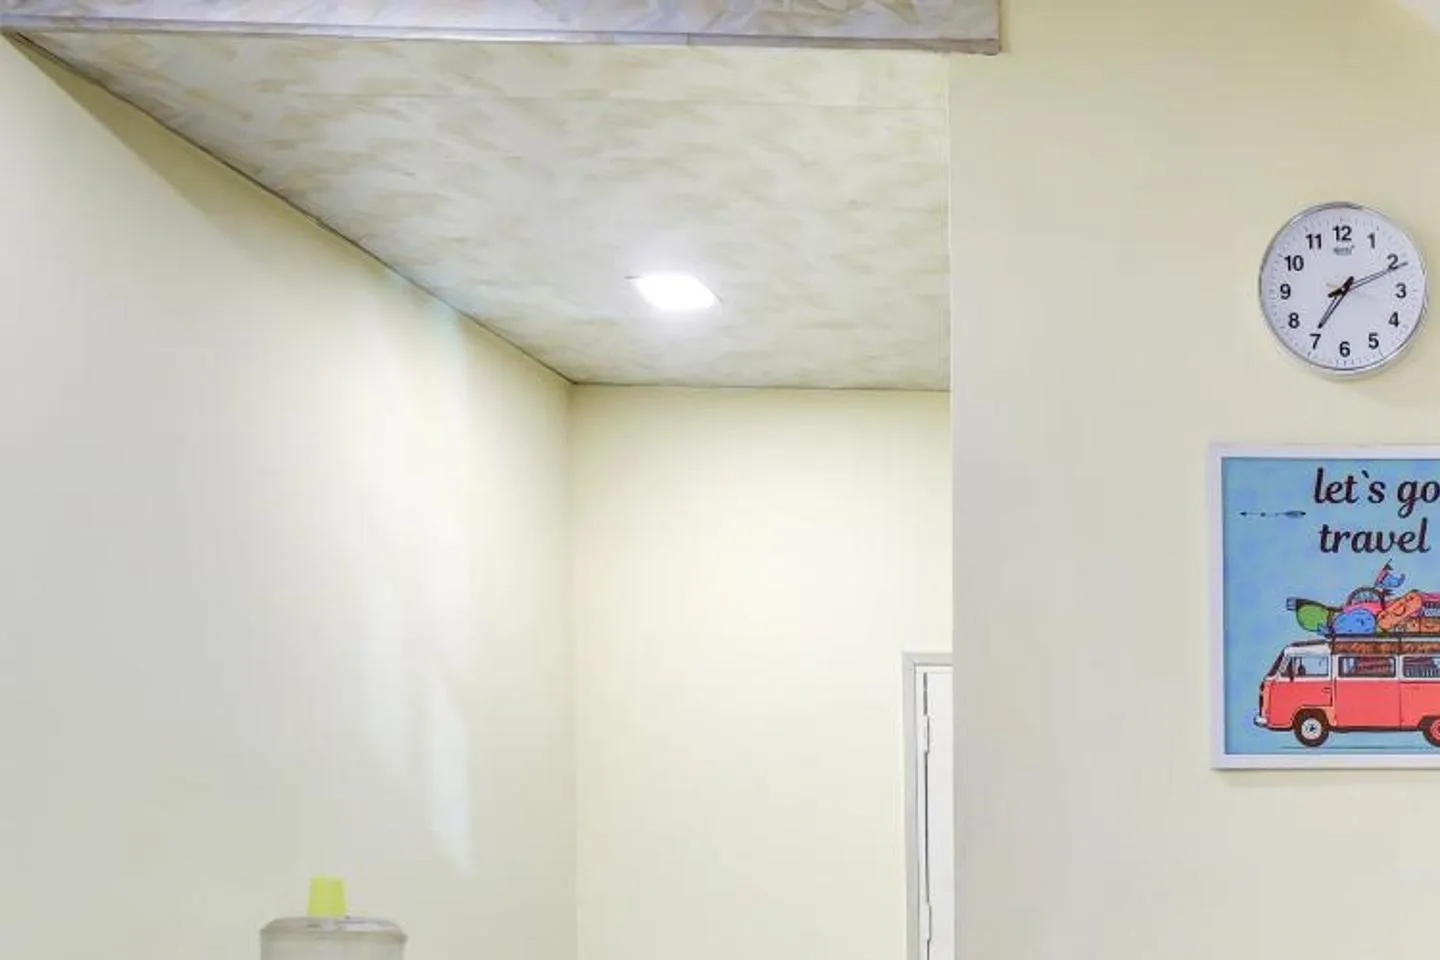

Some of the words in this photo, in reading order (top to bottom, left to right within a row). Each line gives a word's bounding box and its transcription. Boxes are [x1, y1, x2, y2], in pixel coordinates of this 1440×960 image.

[1305, 233, 1322, 250] 11
[1332, 225, 1353, 242] 12
[1366, 232, 1376, 249] 1
[1284, 255, 1304, 271] 10
[1387, 253, 1400, 271] 2
[1280, 283, 1291, 300] 9
[1395, 282, 1407, 299] 3
[1288, 312, 1300, 329] 8
[1388, 311, 1400, 328] 4
[1309, 333, 1321, 350] 7
[1339, 341, 1351, 357] 6
[1368, 332, 1379, 349] 5
[1319, 517, 1431, 553] travel
